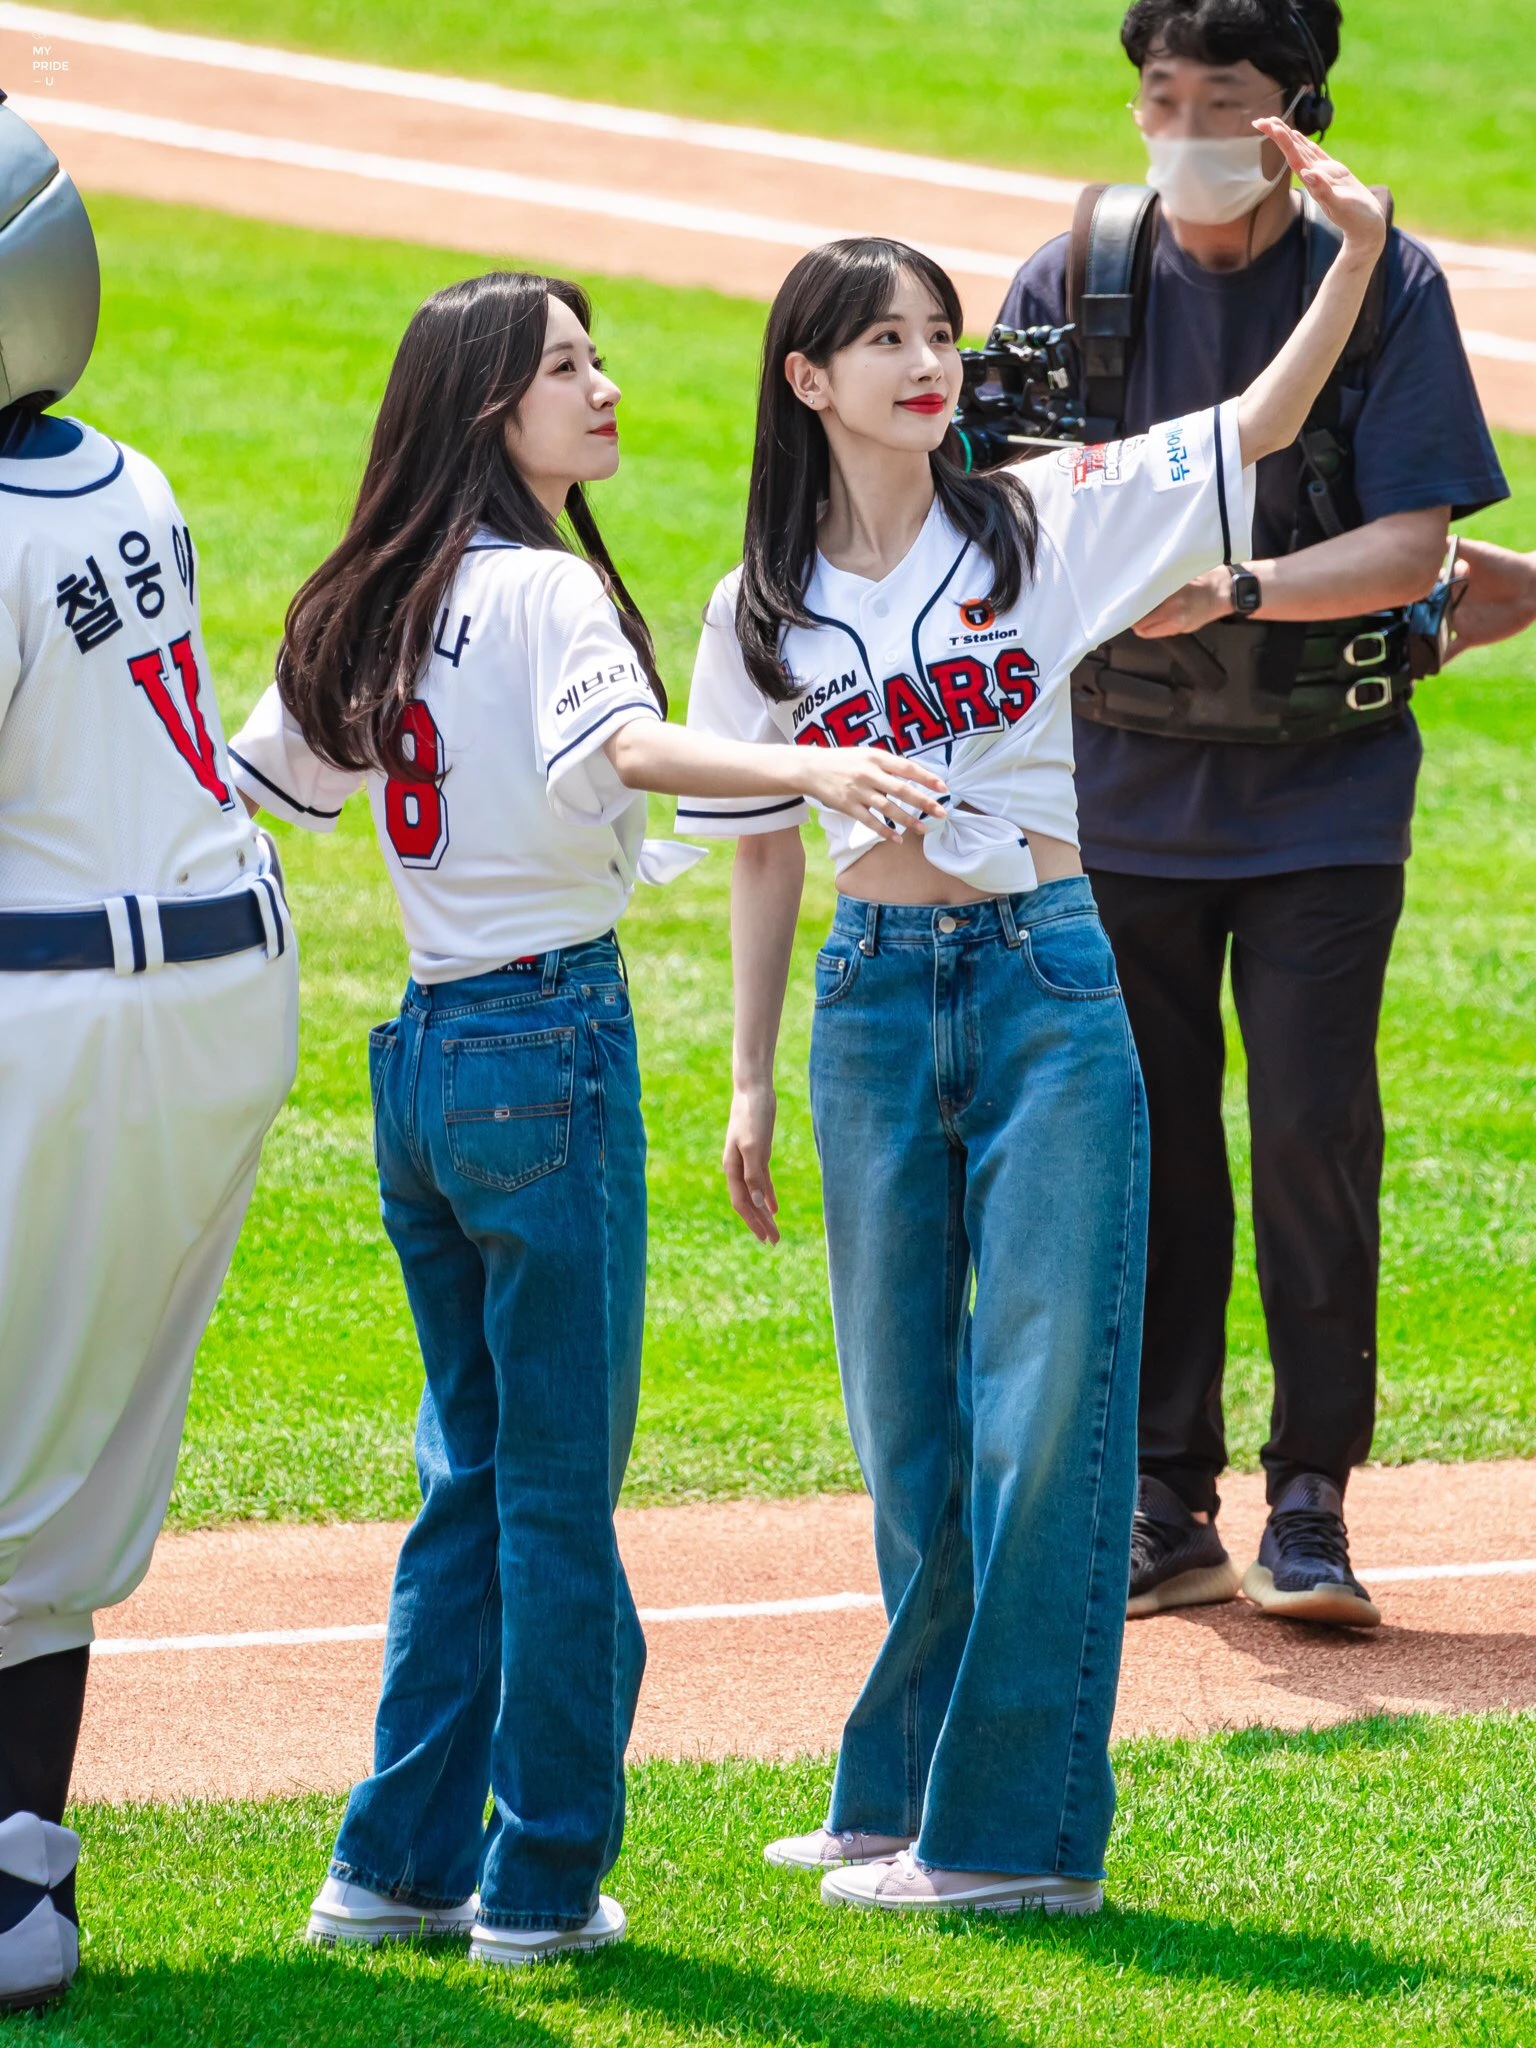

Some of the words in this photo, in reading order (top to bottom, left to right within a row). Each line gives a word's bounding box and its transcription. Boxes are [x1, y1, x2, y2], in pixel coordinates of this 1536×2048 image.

[1165, 421, 1190, 482] 두산에
[56, 524, 195, 655] 철웅이
[556, 662, 650, 715] 에브리
[792, 669, 857, 730] DOOSAN
[127, 630, 236, 812] V
[384, 699, 449, 870] 8
[499, 963, 532, 971] ANS
